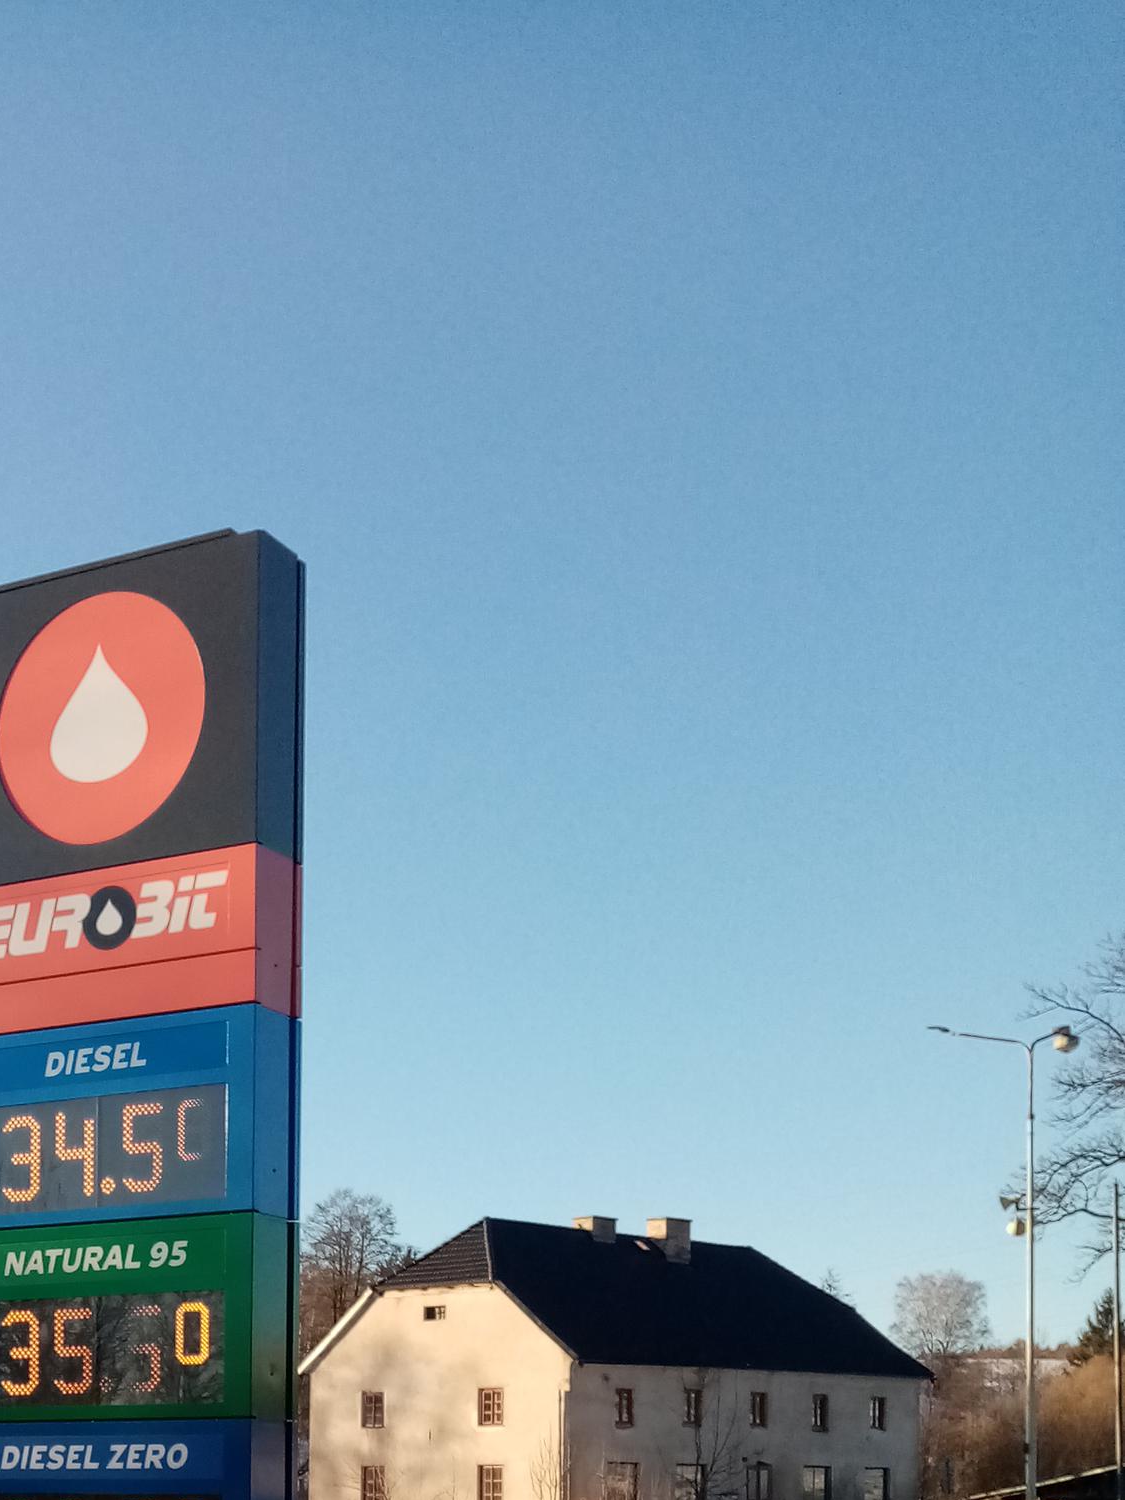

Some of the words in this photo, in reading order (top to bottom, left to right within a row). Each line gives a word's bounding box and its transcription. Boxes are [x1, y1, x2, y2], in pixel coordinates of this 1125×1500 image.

[44, 1041, 147, 1078] DIESEL
[4, 1244, 141, 1277] NATURAL
[148, 1240, 188, 1269] 95
[0, 1445, 100, 1470] DIESEL
[106, 1443, 189, 1470] ZERO
